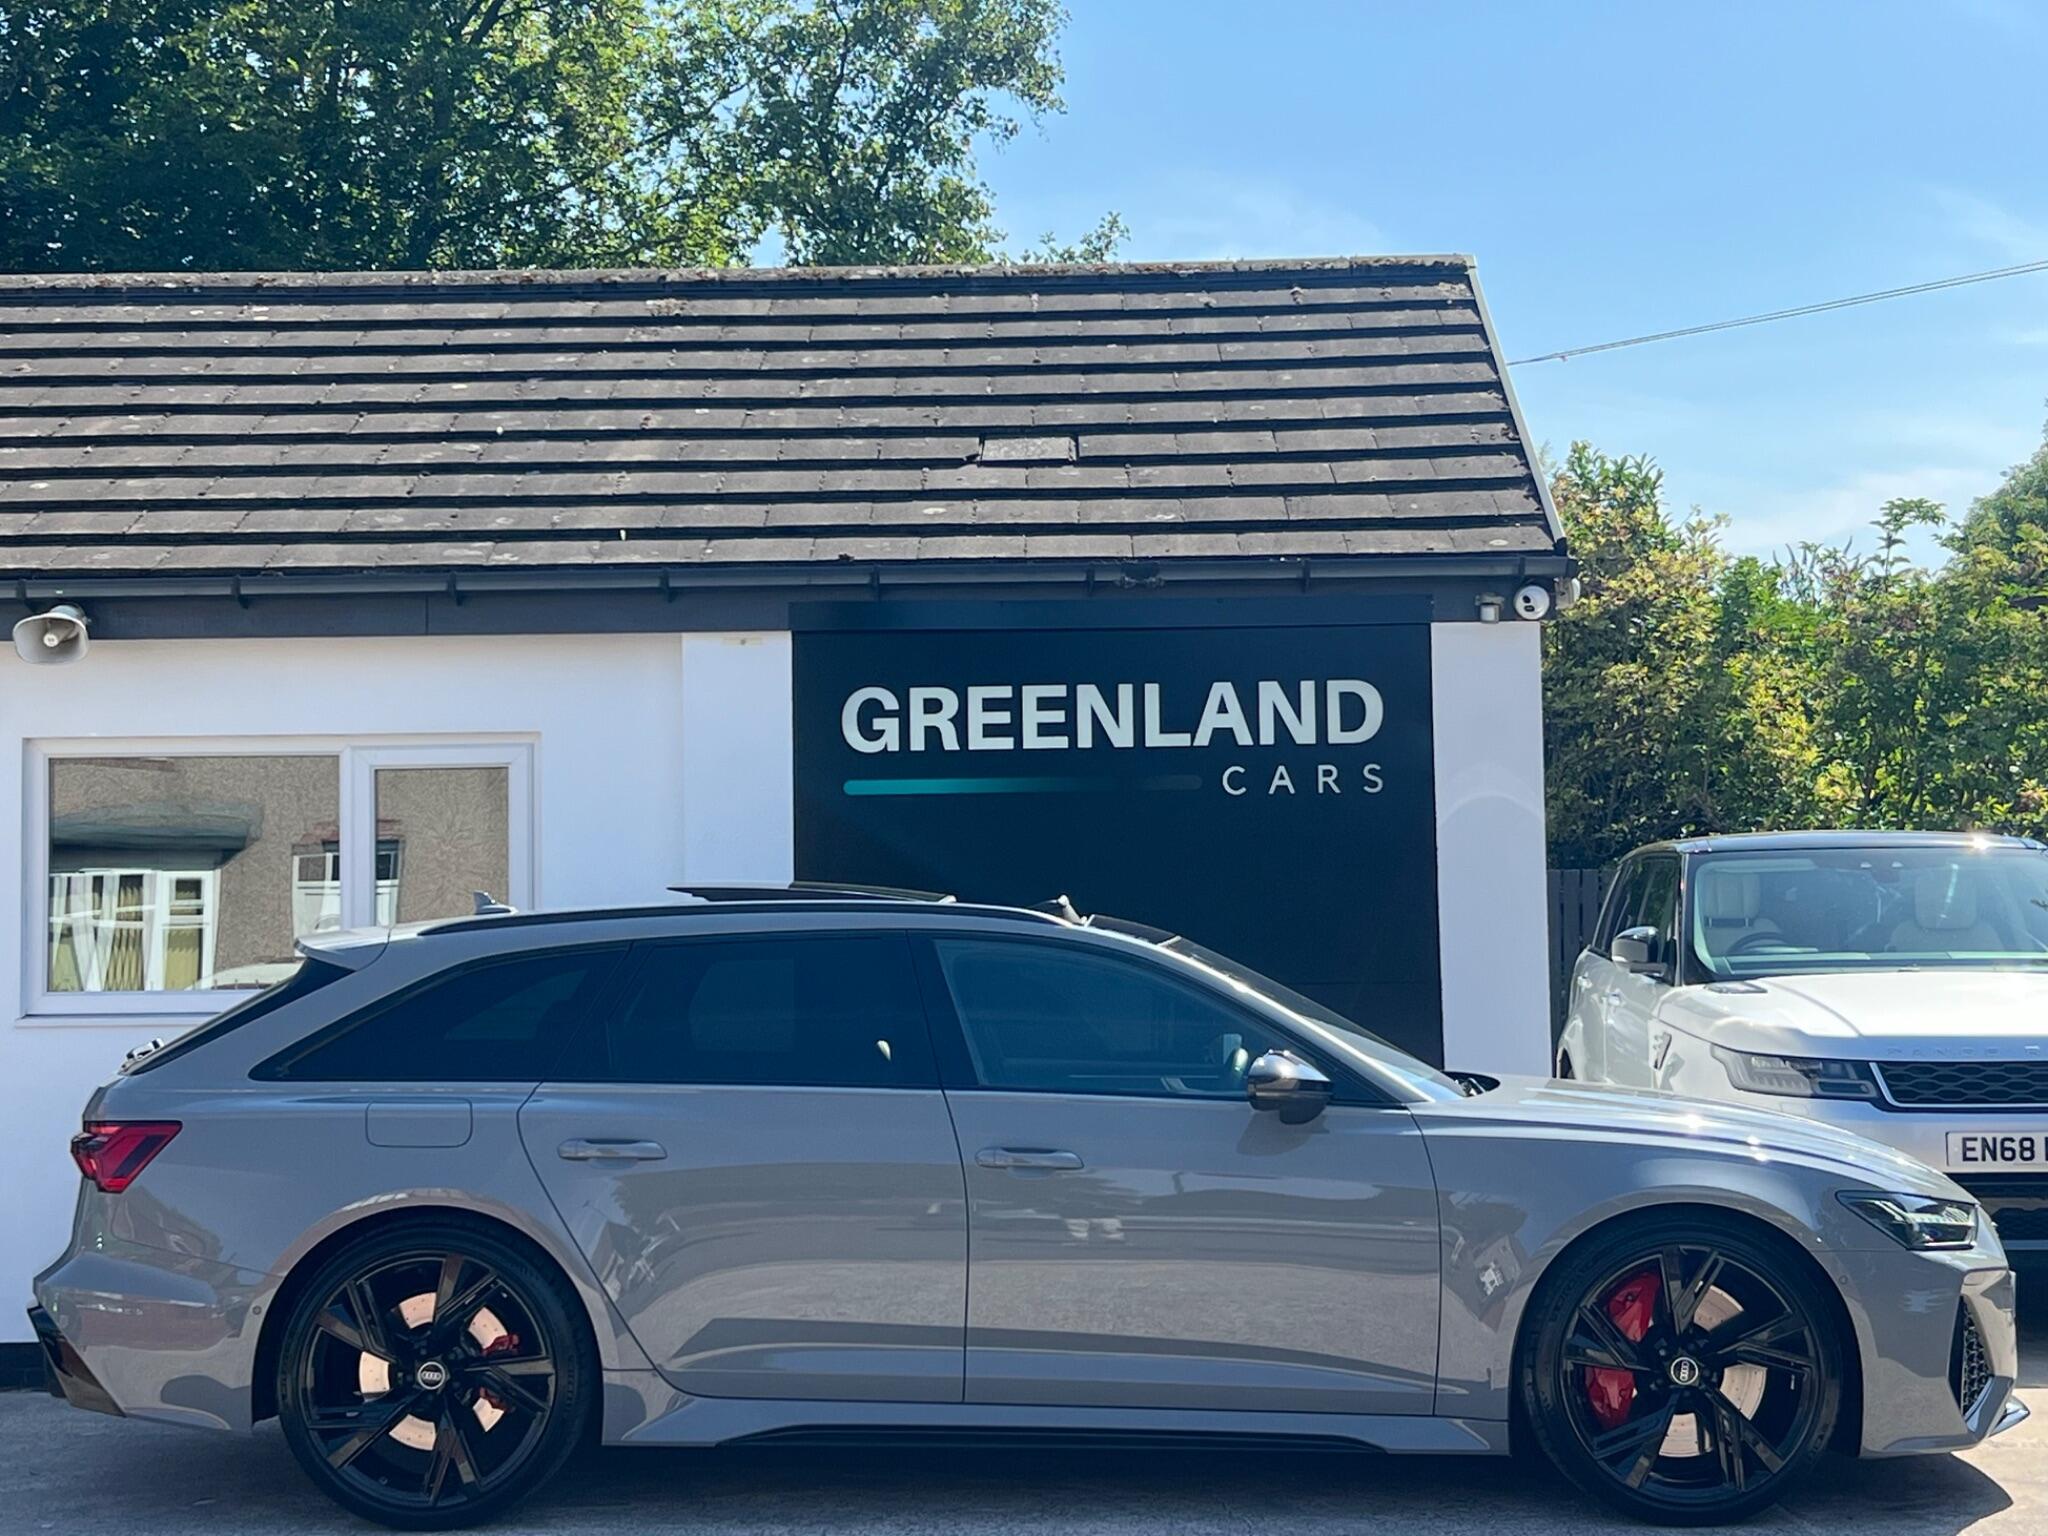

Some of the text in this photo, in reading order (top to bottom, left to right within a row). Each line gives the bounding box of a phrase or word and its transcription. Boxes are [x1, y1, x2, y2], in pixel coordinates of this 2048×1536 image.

[841, 679, 1384, 753] GREENLAND
[1222, 763, 1384, 796] CARS
[1961, 1136, 2036, 1162] EN68
